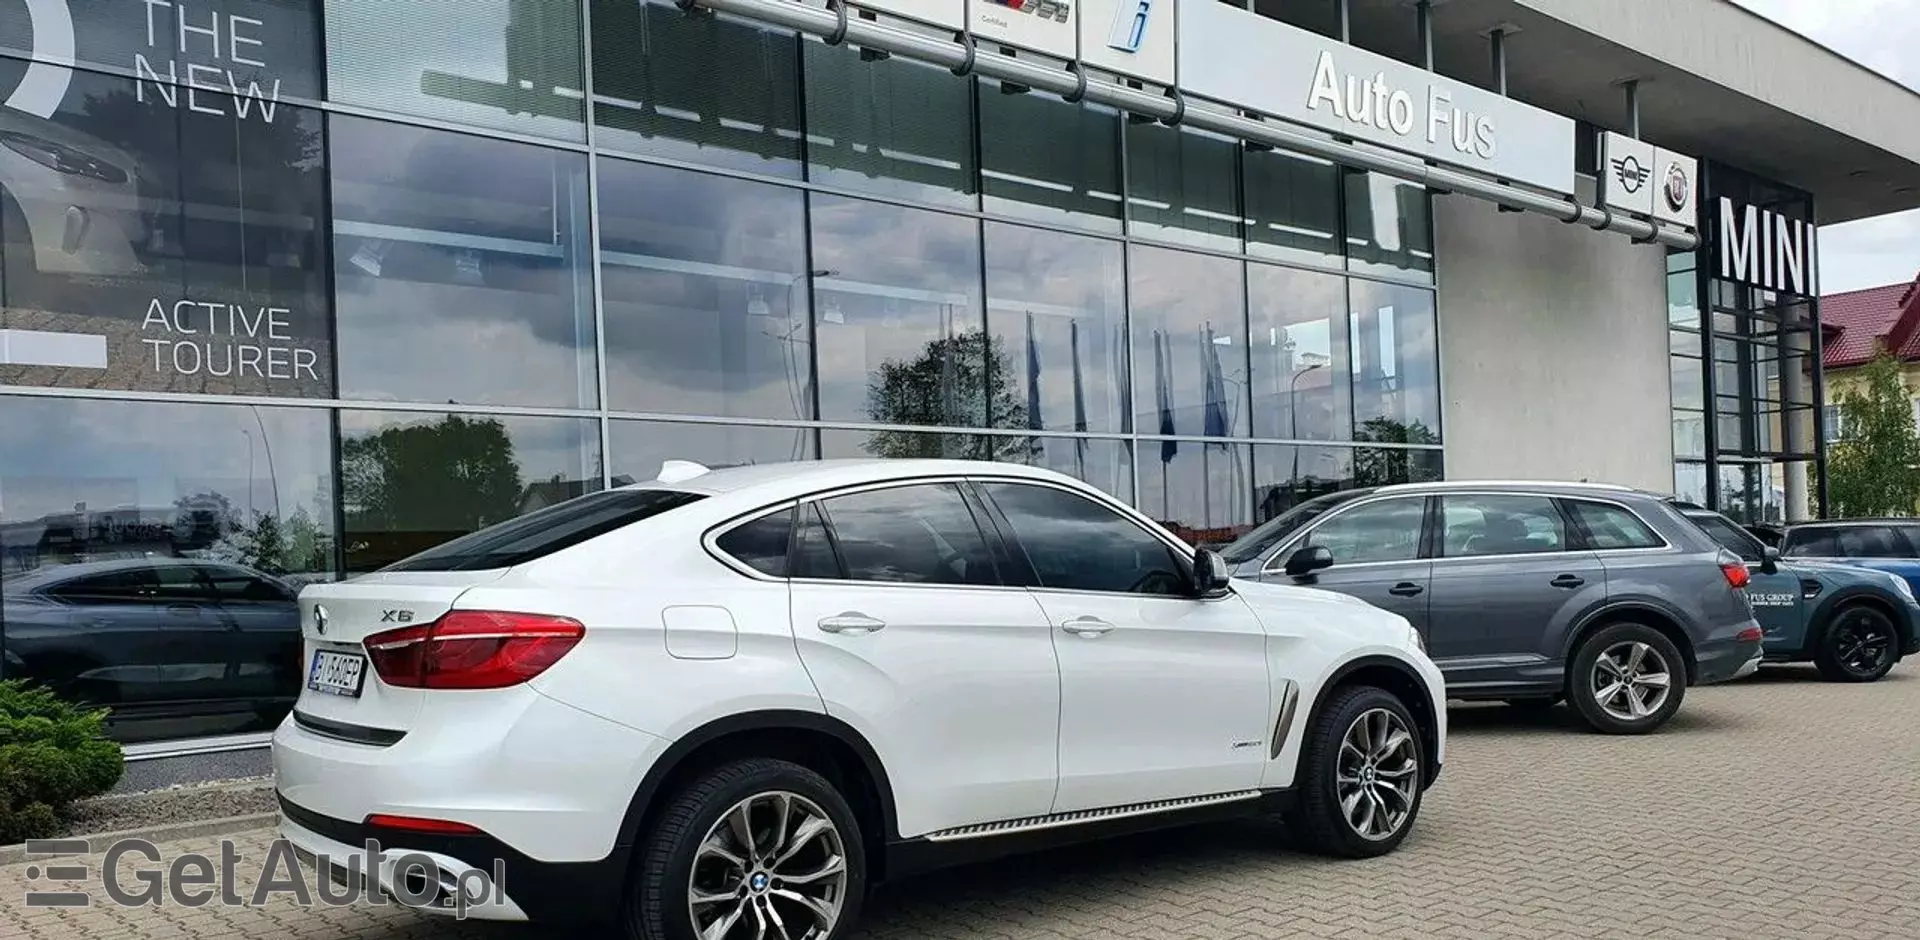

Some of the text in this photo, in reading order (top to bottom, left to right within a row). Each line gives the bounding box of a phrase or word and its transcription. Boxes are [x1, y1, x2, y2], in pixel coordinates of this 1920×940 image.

[145, 0, 266, 68] THE
[135, 53, 281, 123] NEW
[1306, 50, 1497, 159] Auto Fus
[1720, 196, 1816, 297] MINI
[142, 298, 291, 340] ACTIVE
[142, 338, 318, 380] TOURER
[381, 610, 415, 622] X6
